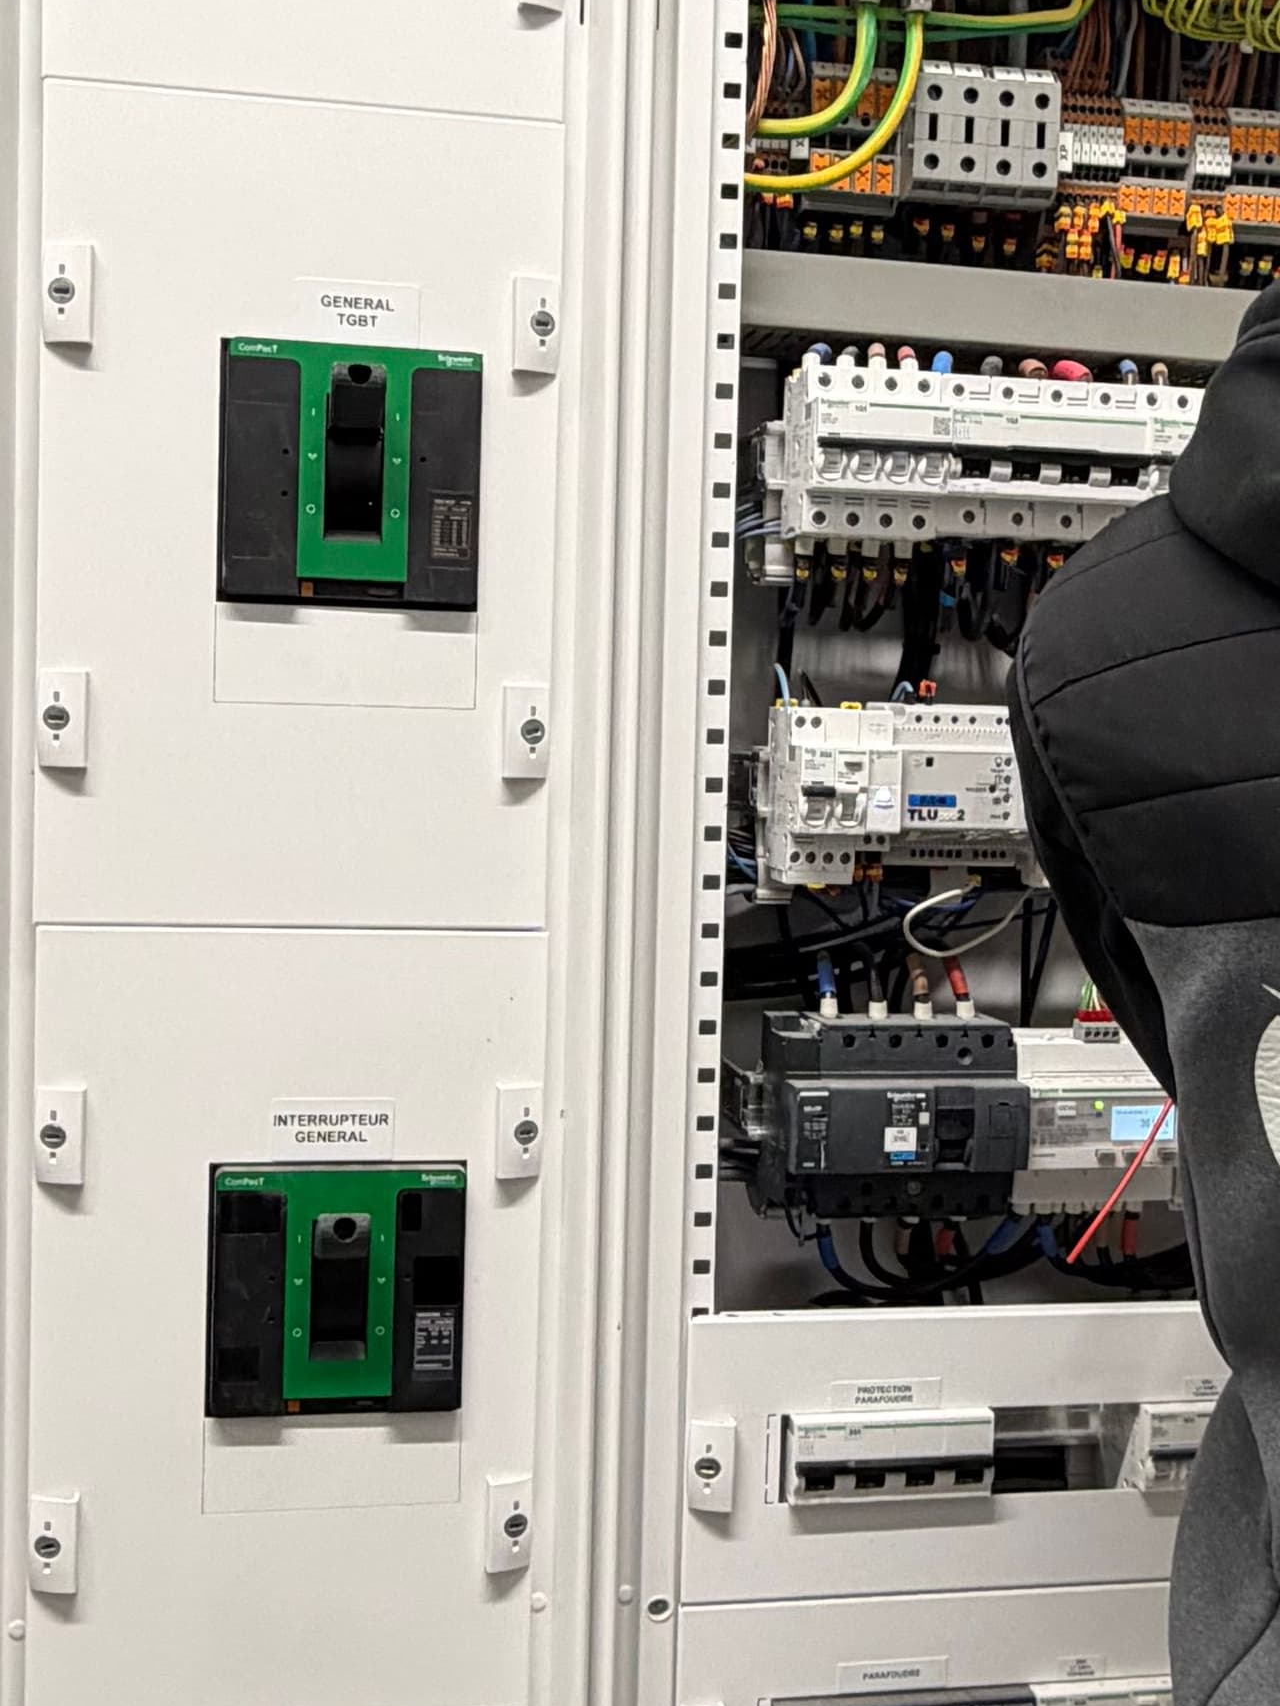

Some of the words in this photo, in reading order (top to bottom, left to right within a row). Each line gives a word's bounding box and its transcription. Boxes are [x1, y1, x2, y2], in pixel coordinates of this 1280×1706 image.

[320, 294, 395, 312] GENERAL
[336, 313, 378, 328] TGBT
[273, 1113, 389, 1127] INTERRUPTEUR
[295, 1131, 368, 1143] GENERAL
[857, 1385, 912, 1395] PROTECTION
